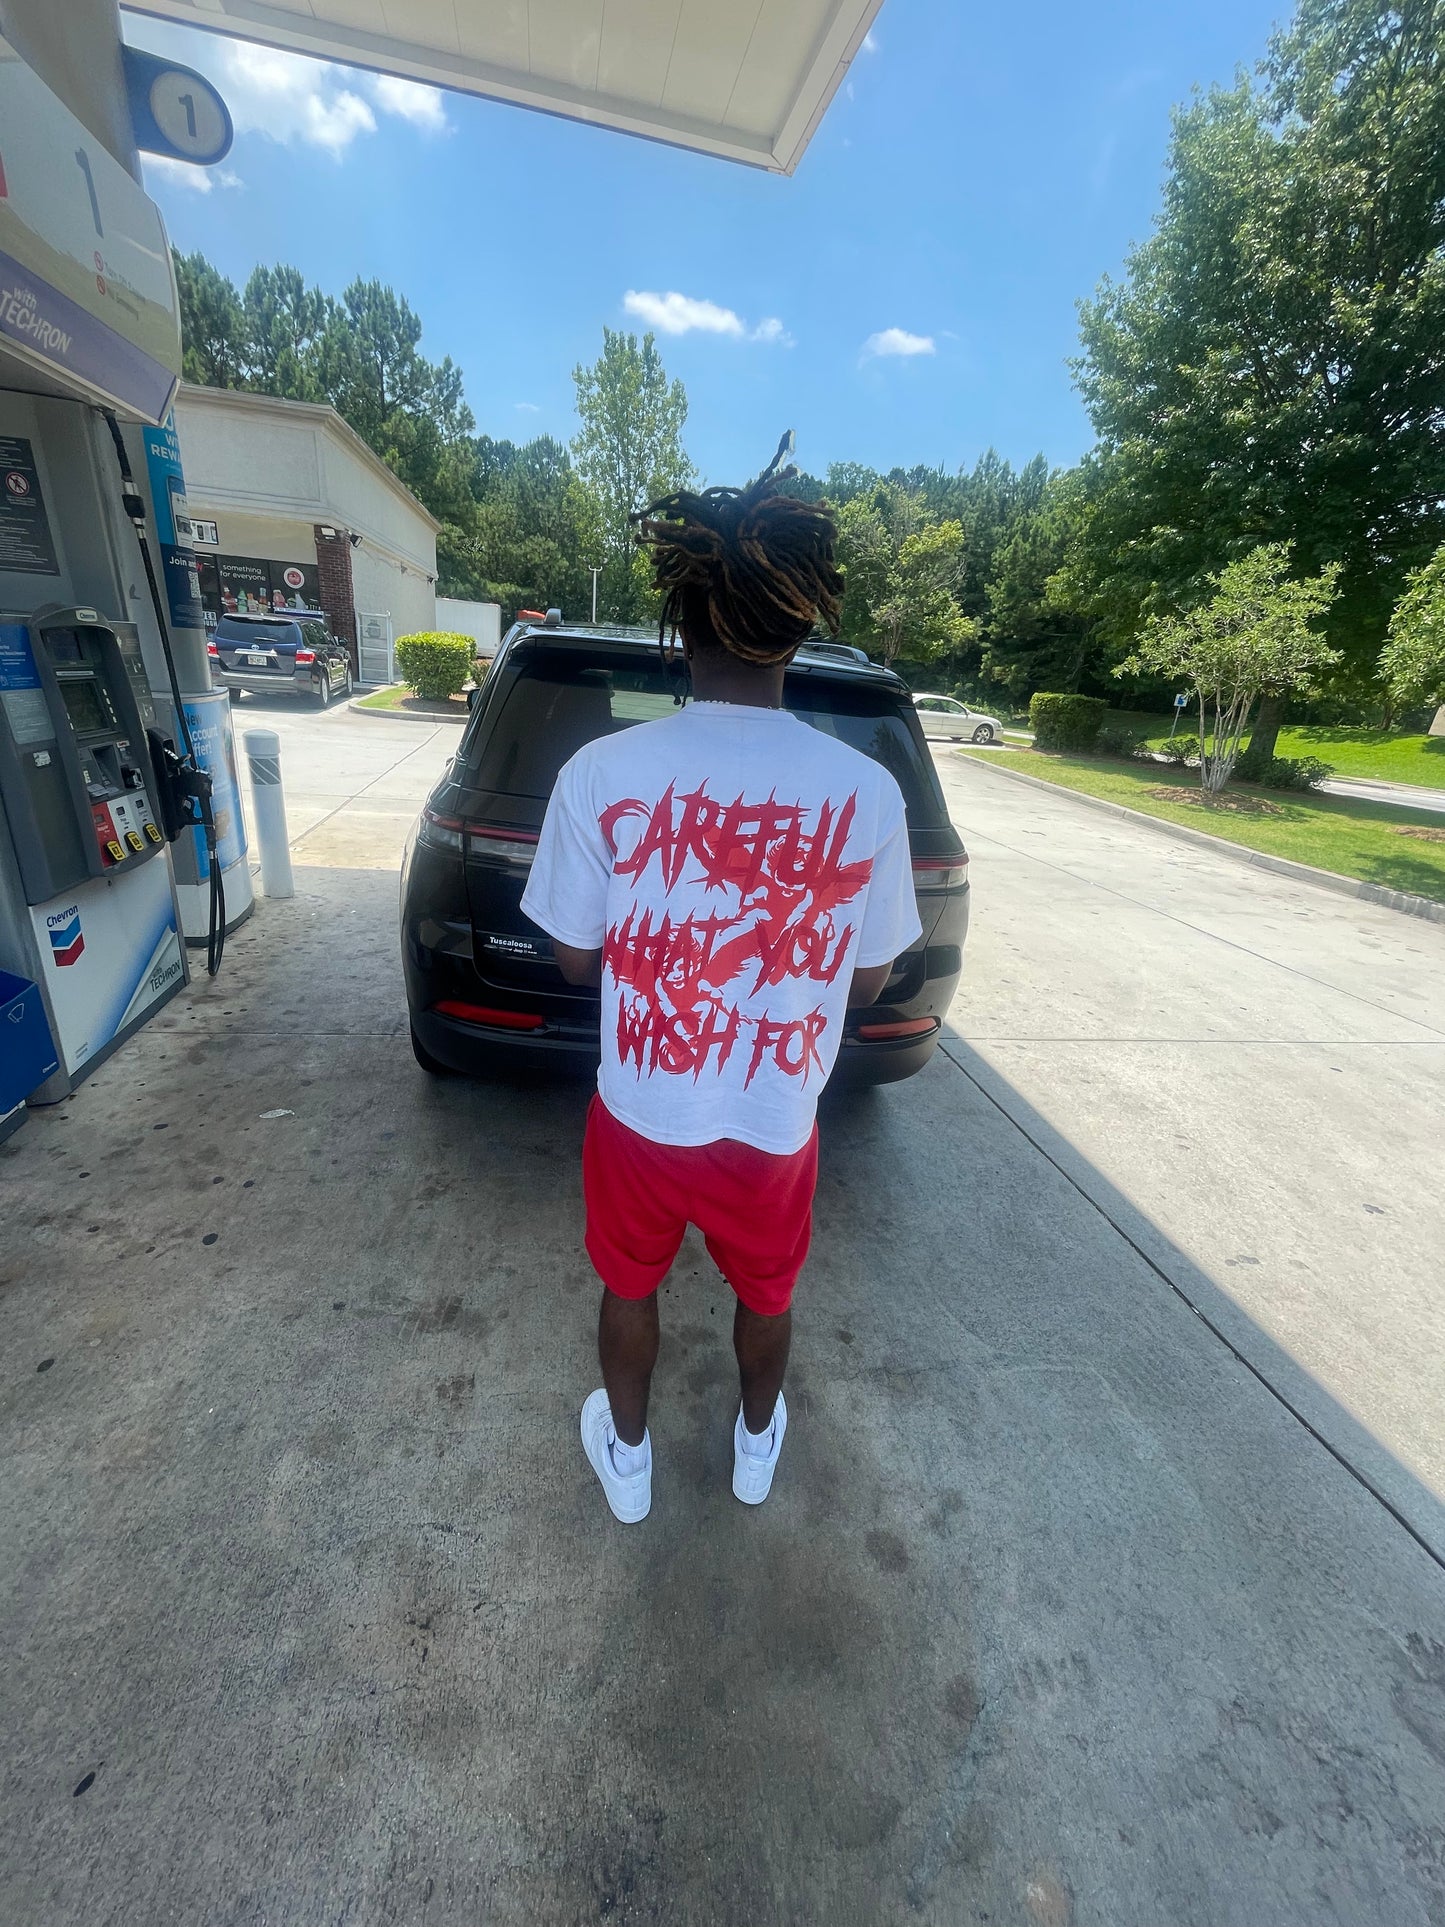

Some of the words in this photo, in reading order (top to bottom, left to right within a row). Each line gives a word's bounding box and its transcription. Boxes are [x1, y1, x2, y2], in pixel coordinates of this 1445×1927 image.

[178, 94, 197, 138] 1
[75, 147, 104, 239] 1
[14, 287, 37, 310] with
[0, 289, 72, 353] TECHRON
[169, 556, 188, 567] Join
[220, 570, 231, 578] for
[232, 571, 266, 581] everyone
[222, 564, 262, 575] something
[189, 723, 218, 742] ccount
[599, 777, 872, 909] CAREFUL
[46, 905, 79, 928] Chevron
[489, 936, 533, 949] Tuscaloosa
[602, 899, 745, 990] WHAT
[748, 917, 856, 1000] YOU
[150, 959, 182, 992] TECHRON
[617, 991, 739, 1086] WISH
[743, 1002, 827, 1092] FOR
